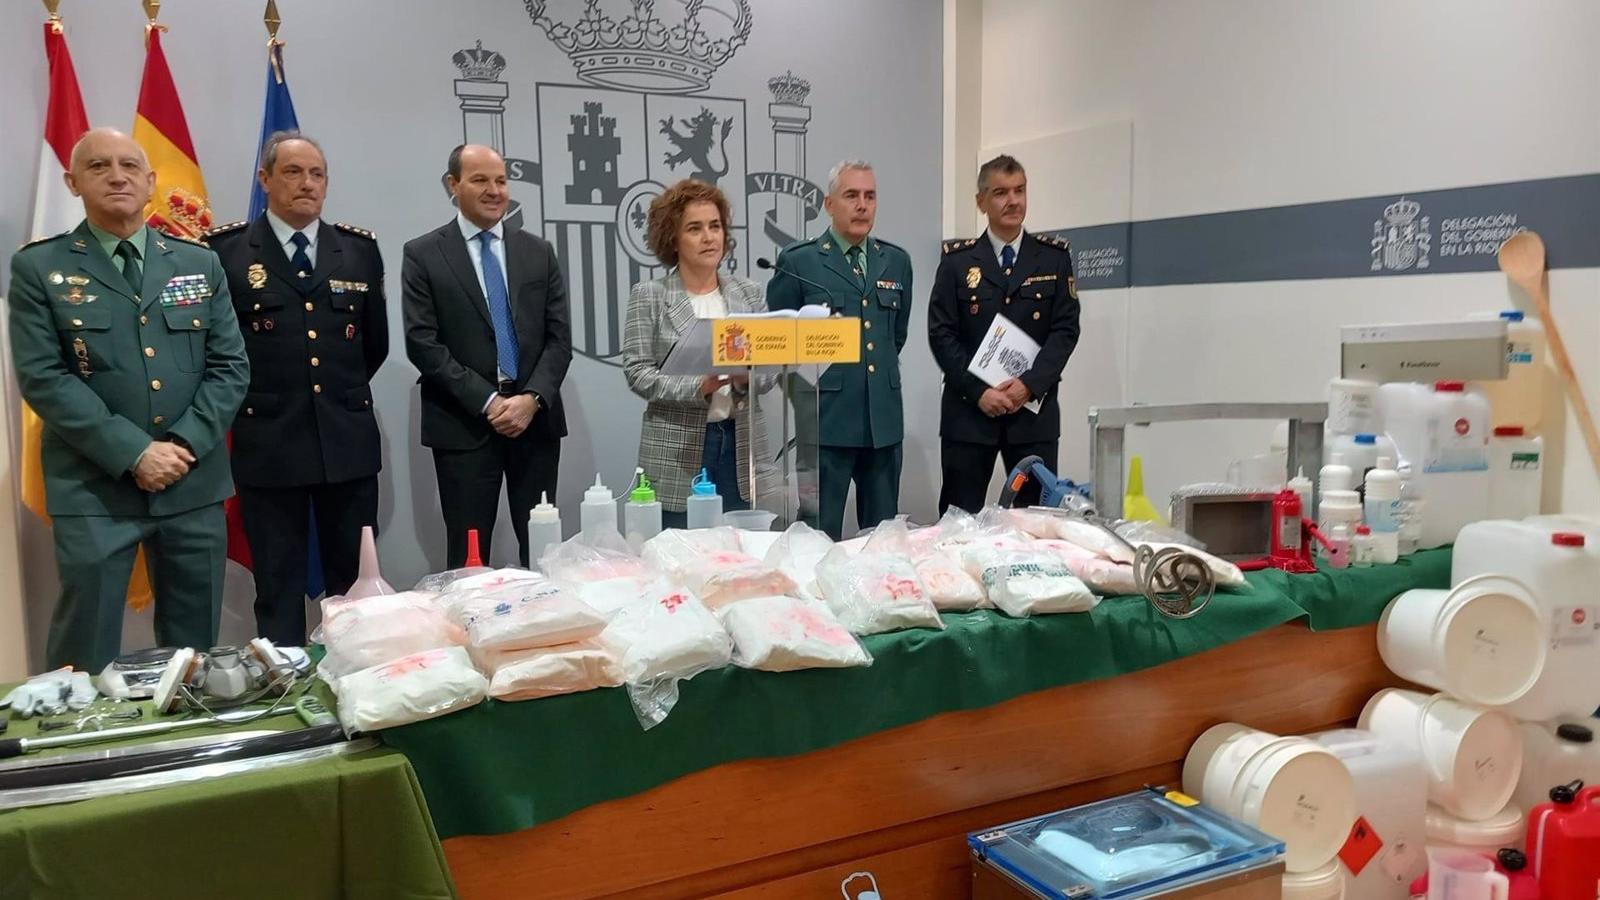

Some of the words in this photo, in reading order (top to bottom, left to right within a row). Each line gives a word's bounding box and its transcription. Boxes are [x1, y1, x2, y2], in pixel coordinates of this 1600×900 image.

[1441, 213, 1517, 231] DELEGACIÓN
[1441, 232, 1461, 244] DEL
[1440, 244, 1456, 256] EN
[1458, 243, 1473, 255] LA
[1475, 241, 1500, 256] RIOJ
